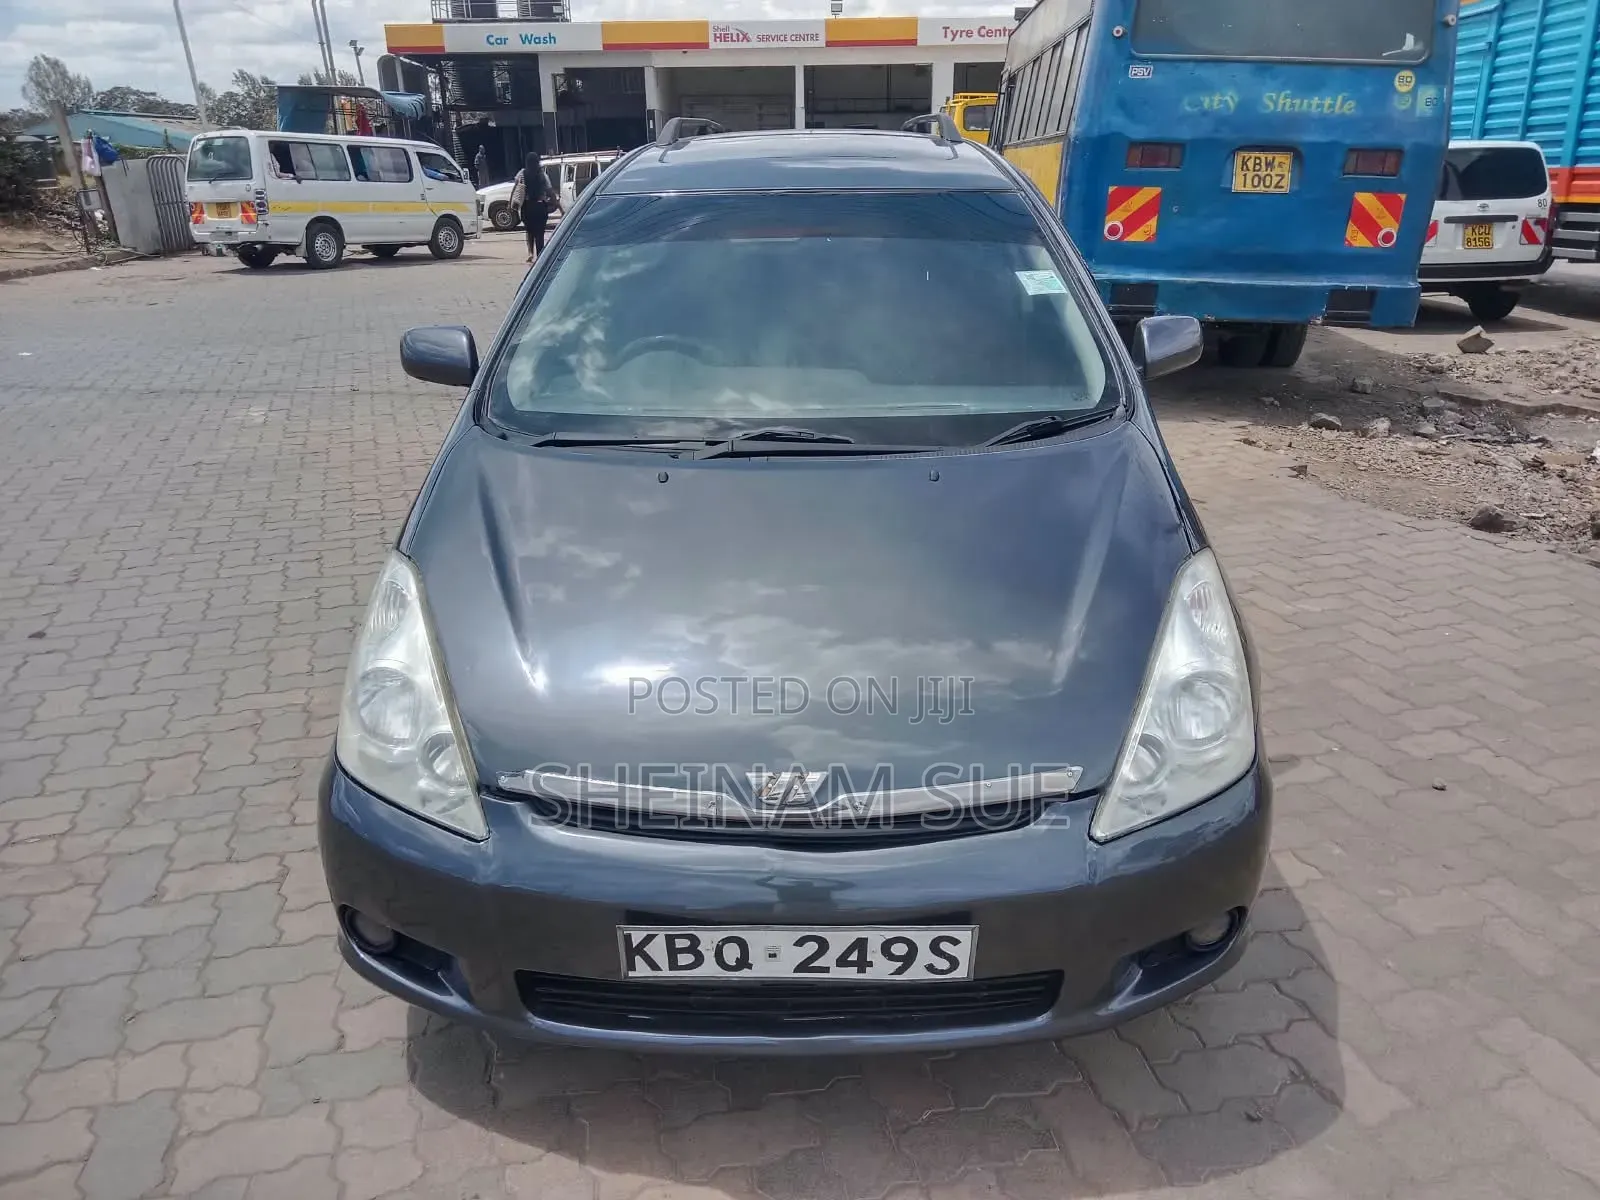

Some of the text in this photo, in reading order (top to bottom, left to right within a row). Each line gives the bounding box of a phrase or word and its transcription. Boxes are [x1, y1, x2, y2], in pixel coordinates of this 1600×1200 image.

[712, 25, 730, 33] Shell
[942, 25, 1014, 42] Tyre Centr
[486, 32, 557, 45] Car Wash
[713, 32, 820, 43] HELIX SERVICE CENTRE
[1131, 67, 1151, 76] PSV
[1261, 90, 1357, 115] Shuttle
[1241, 155, 1276, 172] KBW
[1242, 172, 1286, 189] 100Z
[1537, 199, 1548, 208] 80
[1471, 224, 1491, 236] KCU
[624, 932, 963, 976] KBQ 249S
